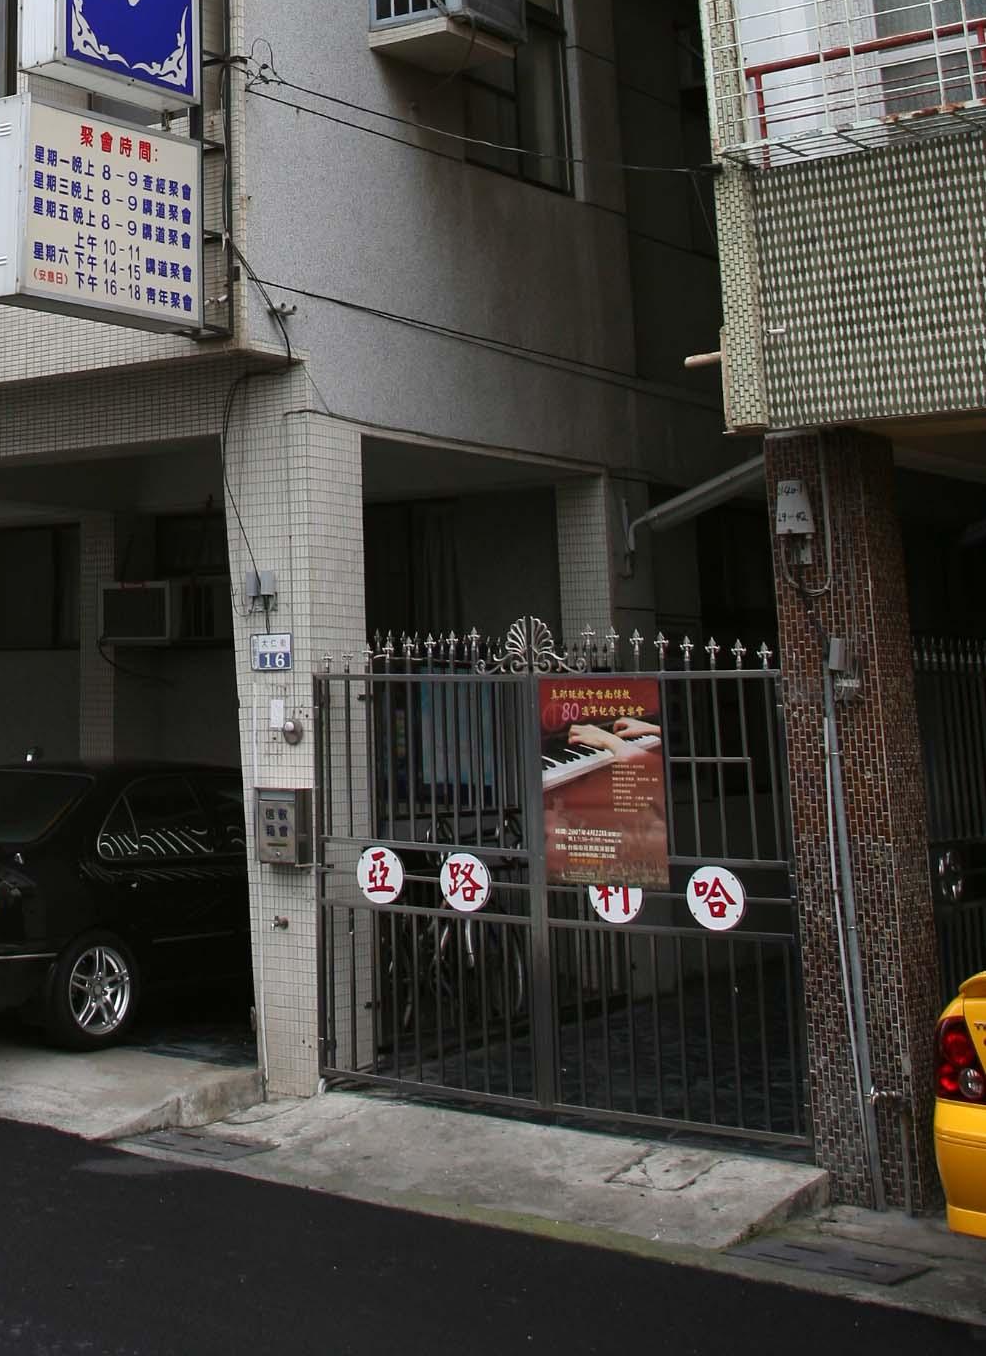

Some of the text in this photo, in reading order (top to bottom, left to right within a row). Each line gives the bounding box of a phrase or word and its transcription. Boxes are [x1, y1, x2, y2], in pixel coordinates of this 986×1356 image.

[34, 145, 95, 177] 星期一晚上
[33, 170, 94, 202] 星期三晚上
[33, 196, 96, 227] 星期五晚上
[74, 231, 97, 252] 上午
[33, 241, 69, 266] 星期六
[74, 251, 97, 272] 下午
[74, 271, 98, 292] 下午
[264, 652, 285, 668] 16
[561, 702, 579, 721] 80
